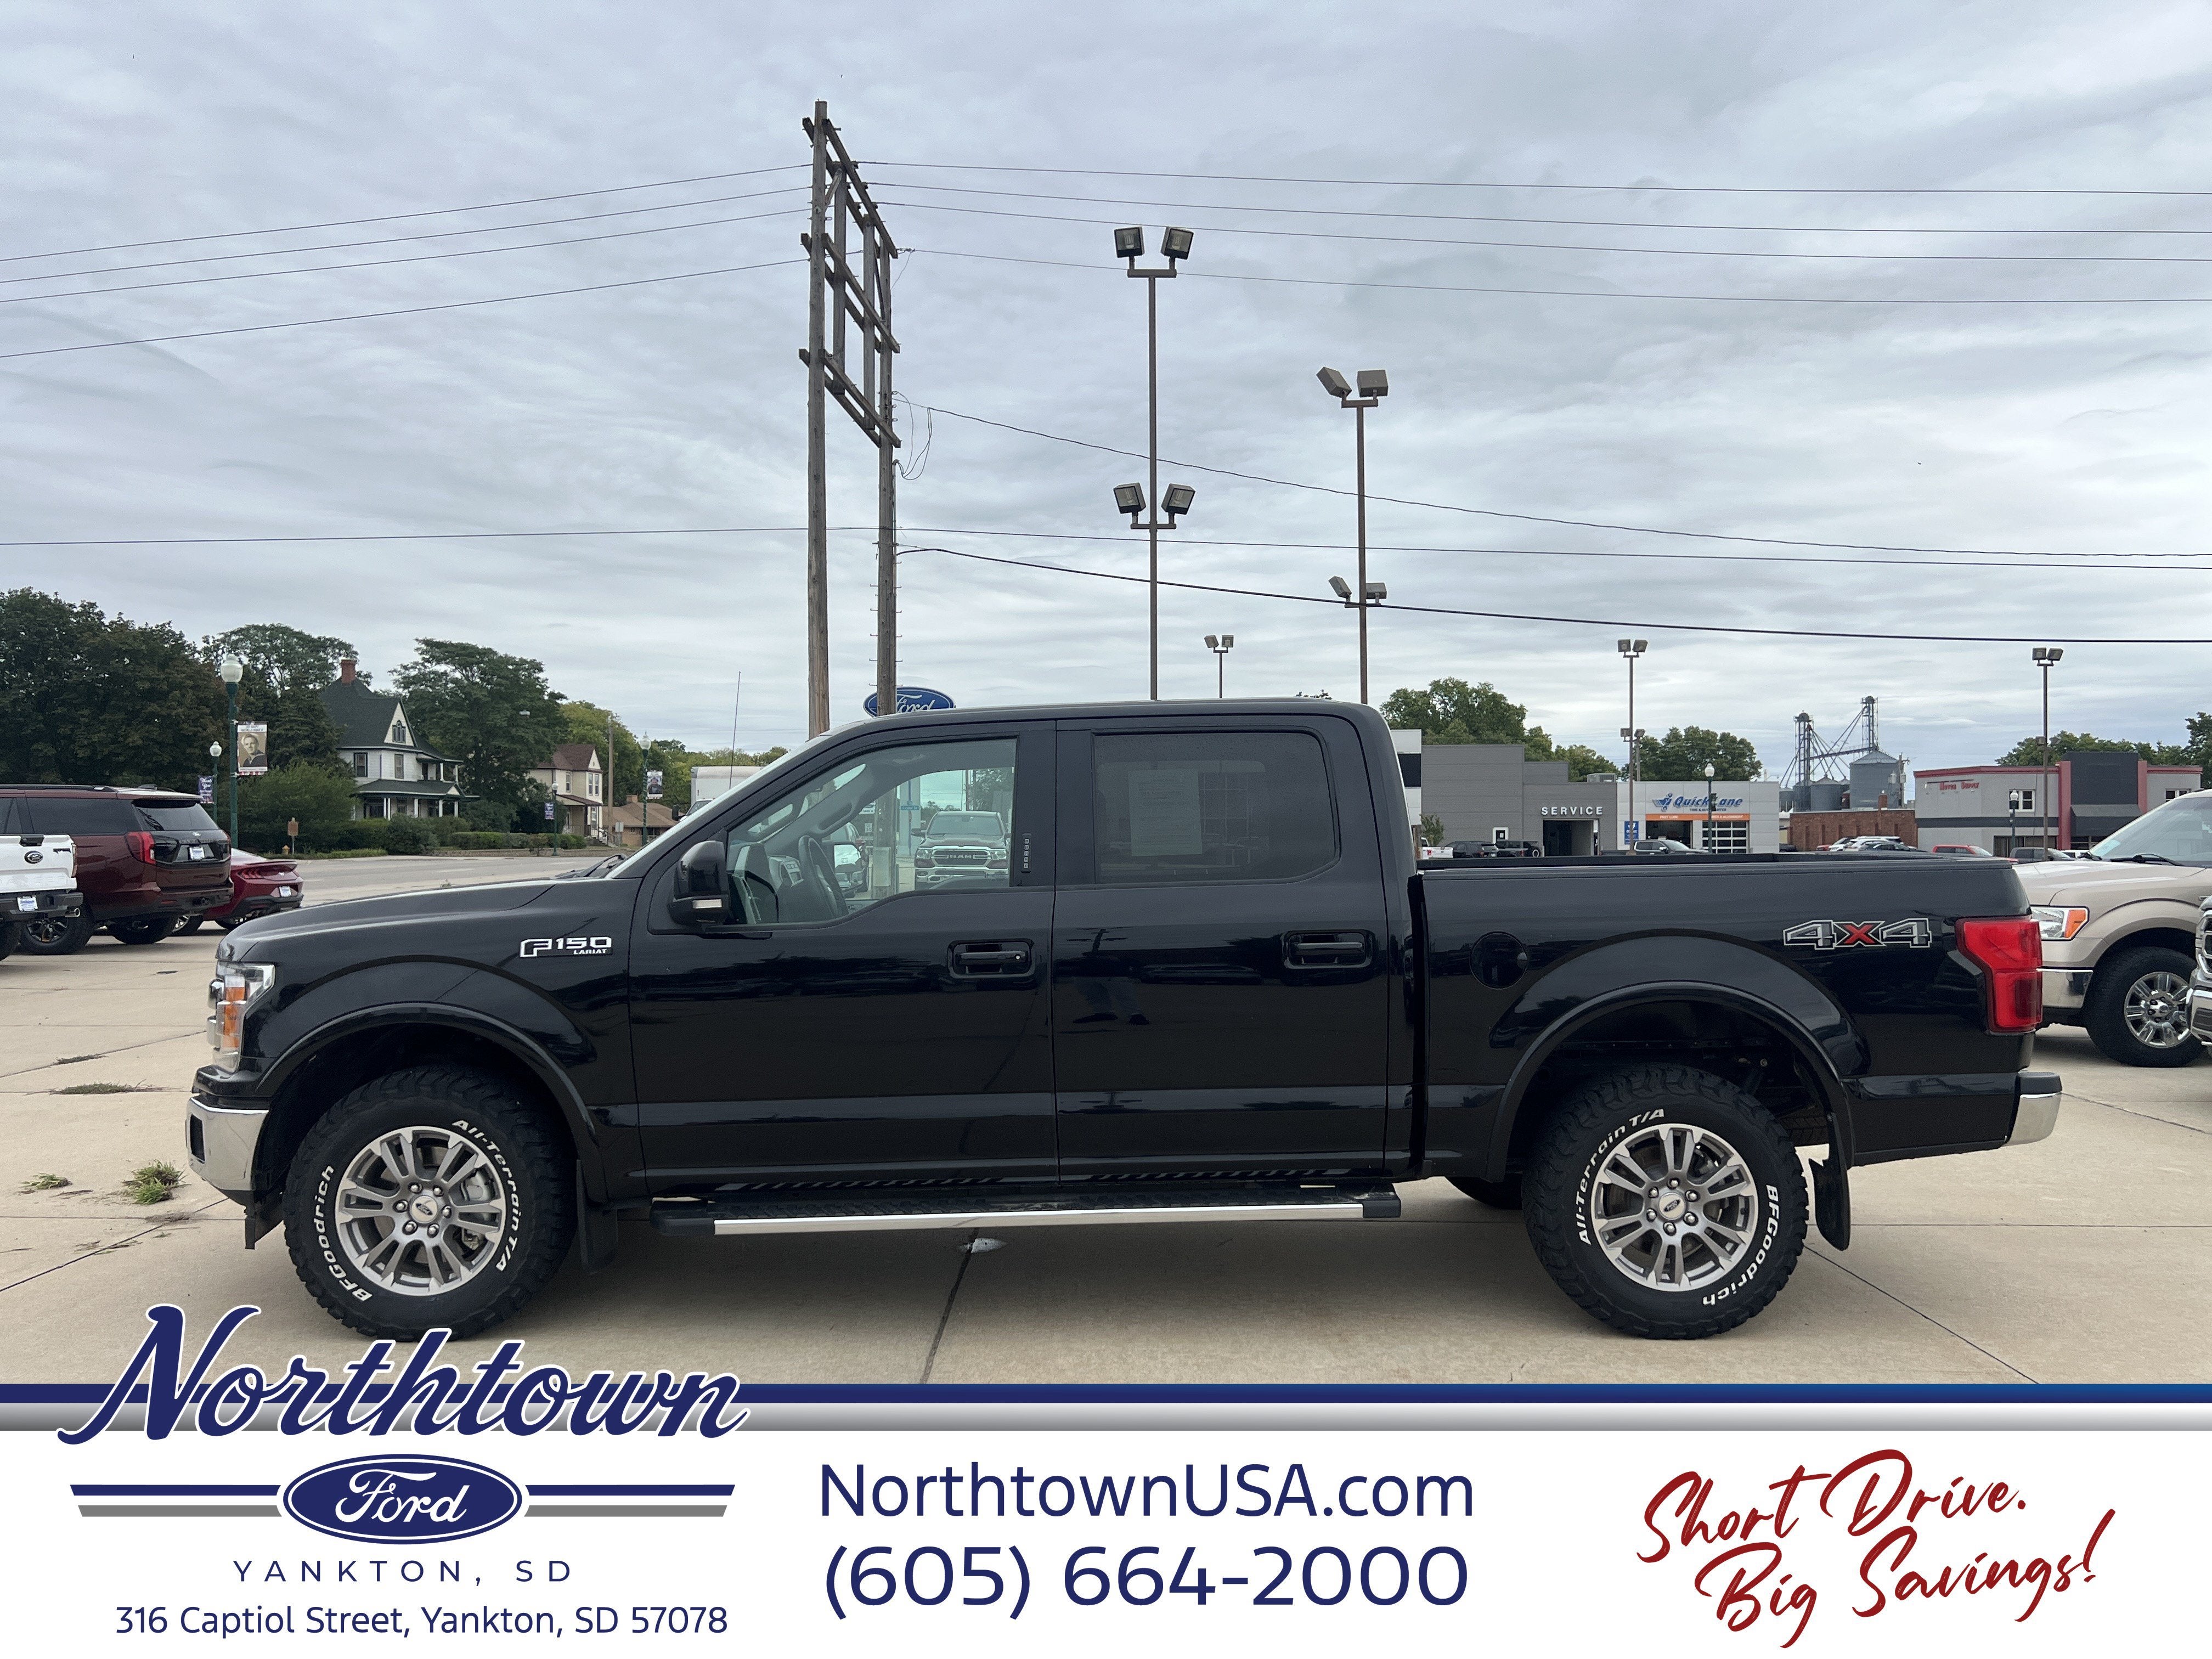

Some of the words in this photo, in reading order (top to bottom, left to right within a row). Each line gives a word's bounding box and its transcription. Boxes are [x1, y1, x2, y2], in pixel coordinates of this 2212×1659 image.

[1541, 806, 1602, 815] SERVICE
[1674, 796, 1709, 808] Quick
[313, 1165, 374, 1301] BFGoodrich
[452, 1119, 520, 1230] All-Terrain
[495, 1236, 518, 1272] T/A
[1575, 1124, 1627, 1245] All-Terrain
[1628, 1108, 1664, 1128] T/A
[1702, 1184, 1780, 1306] BFGoodrich
